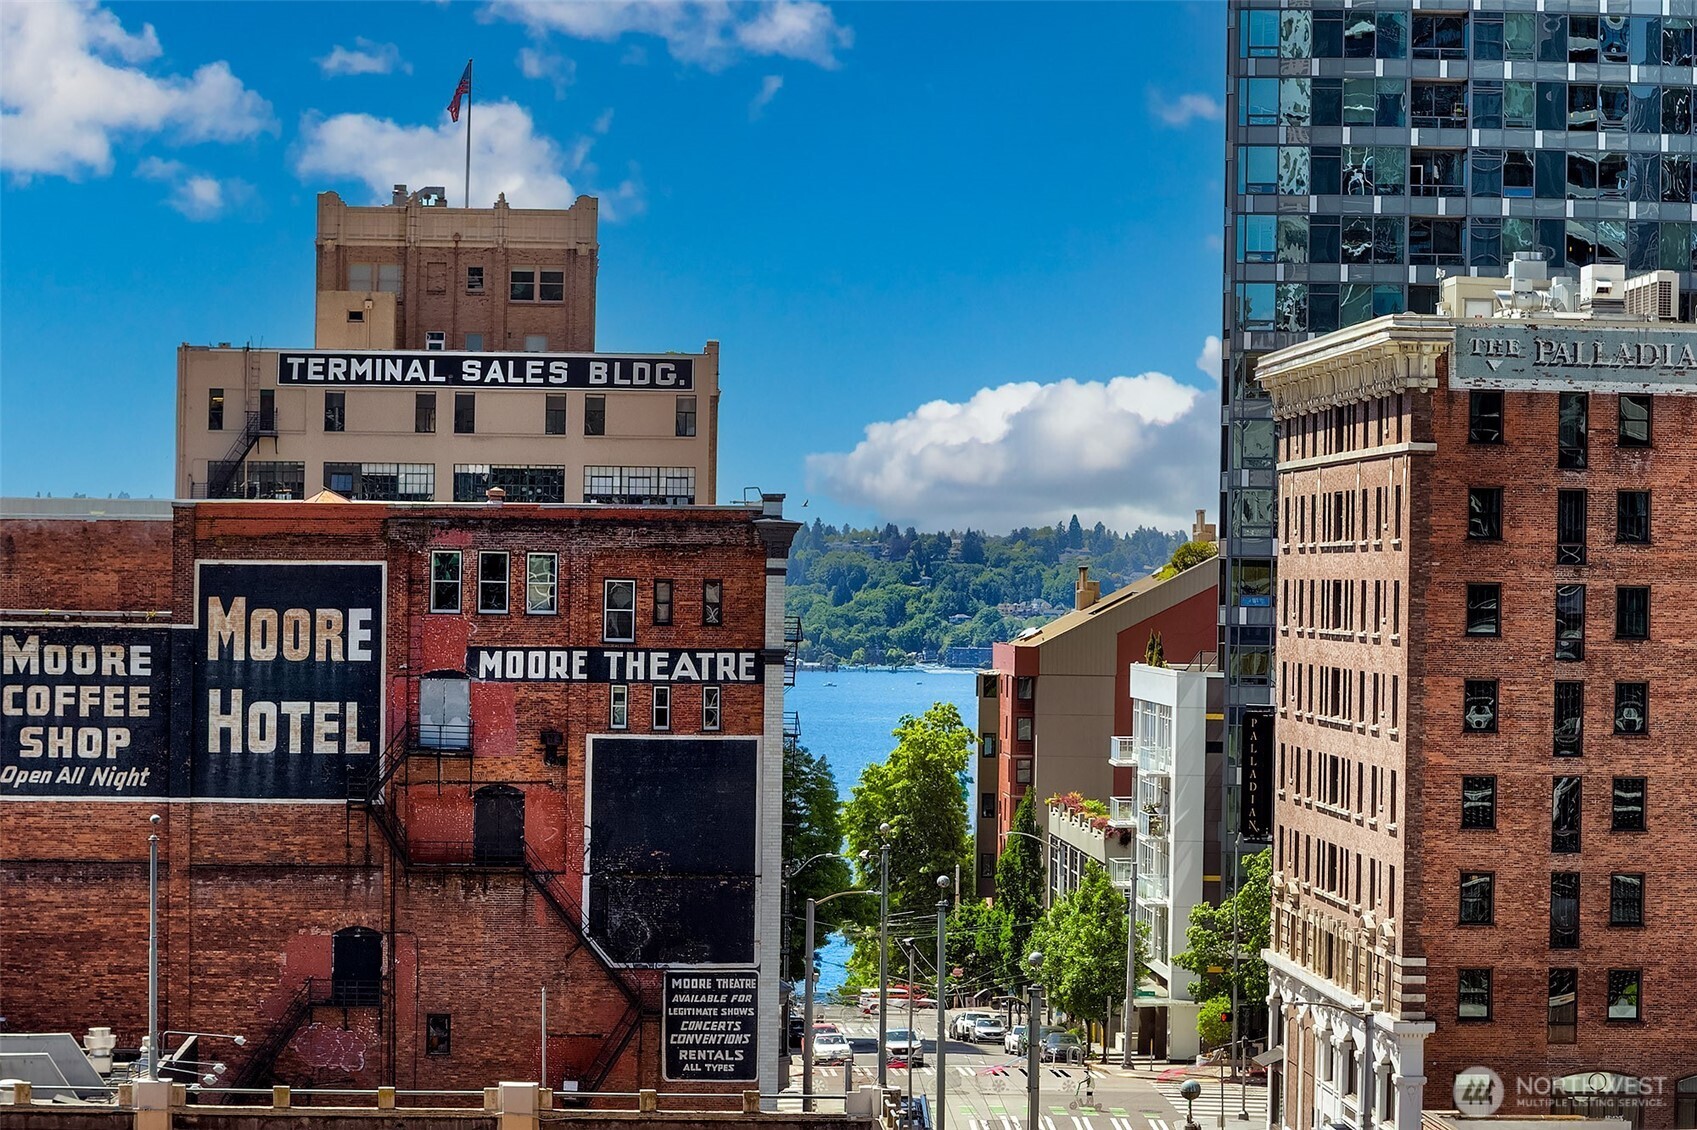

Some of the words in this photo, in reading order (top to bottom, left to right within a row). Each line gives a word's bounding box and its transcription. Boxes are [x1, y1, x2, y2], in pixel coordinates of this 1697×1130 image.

[1468, 338, 1521, 356] THE
[287, 357, 446, 383] TERMINAL
[462, 359, 568, 384] SALES
[589, 361, 686, 387] BLDG.
[207, 595, 372, 662] MOORE
[2, 635, 152, 676] MOORE
[478, 650, 588, 680] MOORE
[603, 651, 756, 681] THEATRE
[2, 684, 150, 717] COFFEE
[208, 688, 371, 754] HOTEL
[19, 726, 131, 759] SHOP
[0, 765, 53, 788] Open
[55, 766, 86, 784] All
[89, 766, 150, 791] Night
[1248, 718, 1260, 833] PALLADIAN
[671, 978, 712, 989] MOORE
[716, 978, 757, 989] THEATRE
[668, 1007, 718, 1016] LEGITIMATE
[720, 1007, 755, 1016] SHOWS
[671, 994, 728, 1003] AVAILABLE
[730, 994, 753, 1003] FOR
[670, 1034, 751, 1044] CONVENTIONS
[680, 1021, 742, 1031] CONCERTS
[679, 1049, 744, 1061] RENTALS
[682, 1063, 702, 1072] ALL
[704, 1063, 735, 1072] TYPES
